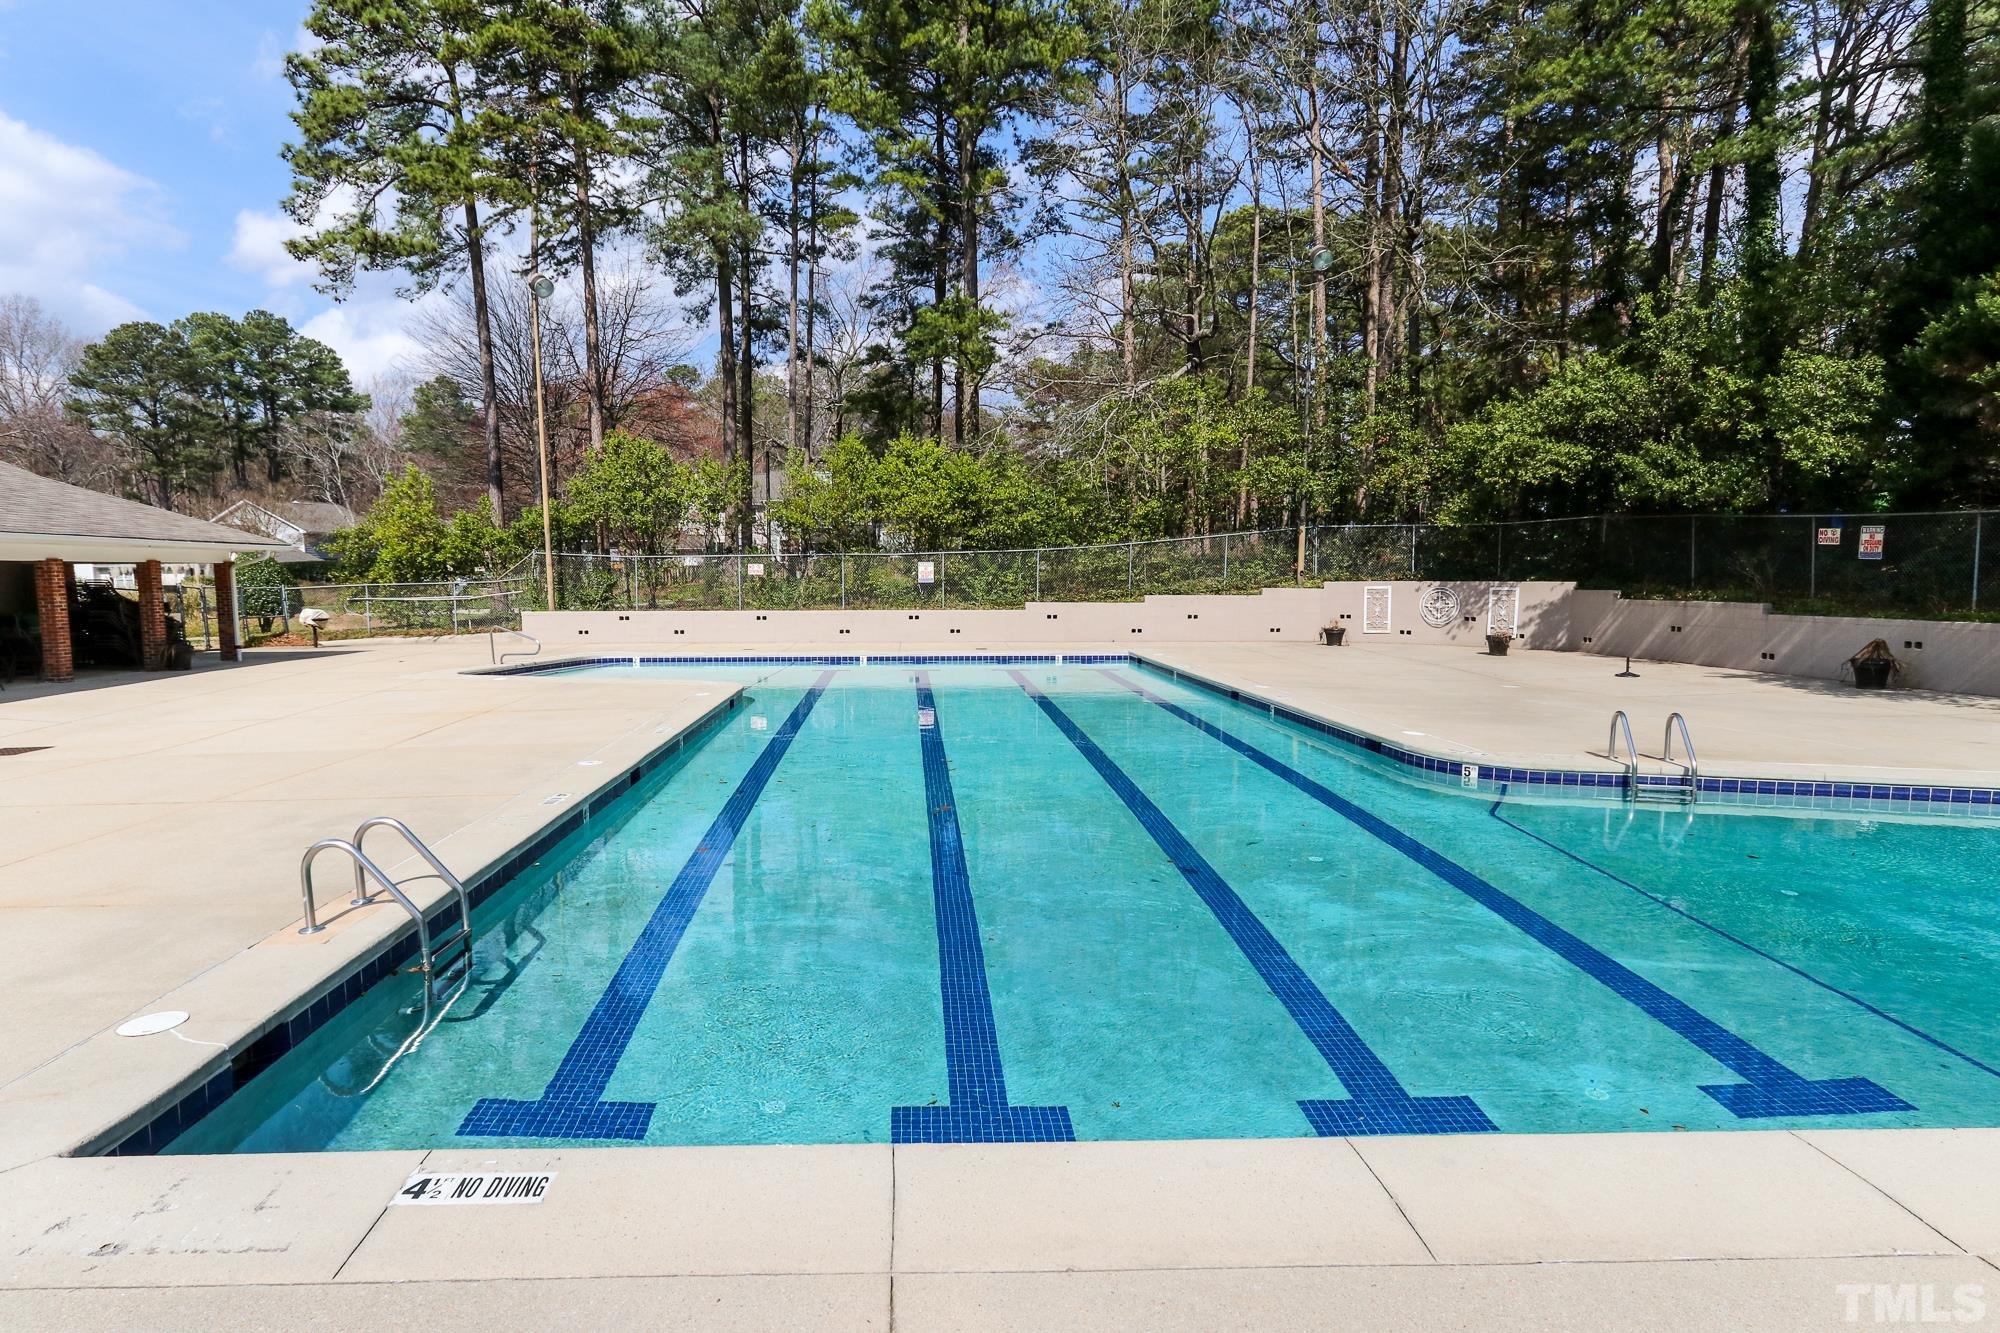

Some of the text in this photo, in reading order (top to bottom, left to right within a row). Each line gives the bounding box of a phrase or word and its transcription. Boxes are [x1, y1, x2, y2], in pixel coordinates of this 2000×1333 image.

[1464, 766, 1471, 777] 5
[451, 1177, 484, 1198] NO
[482, 1177, 549, 1198] DIVING
